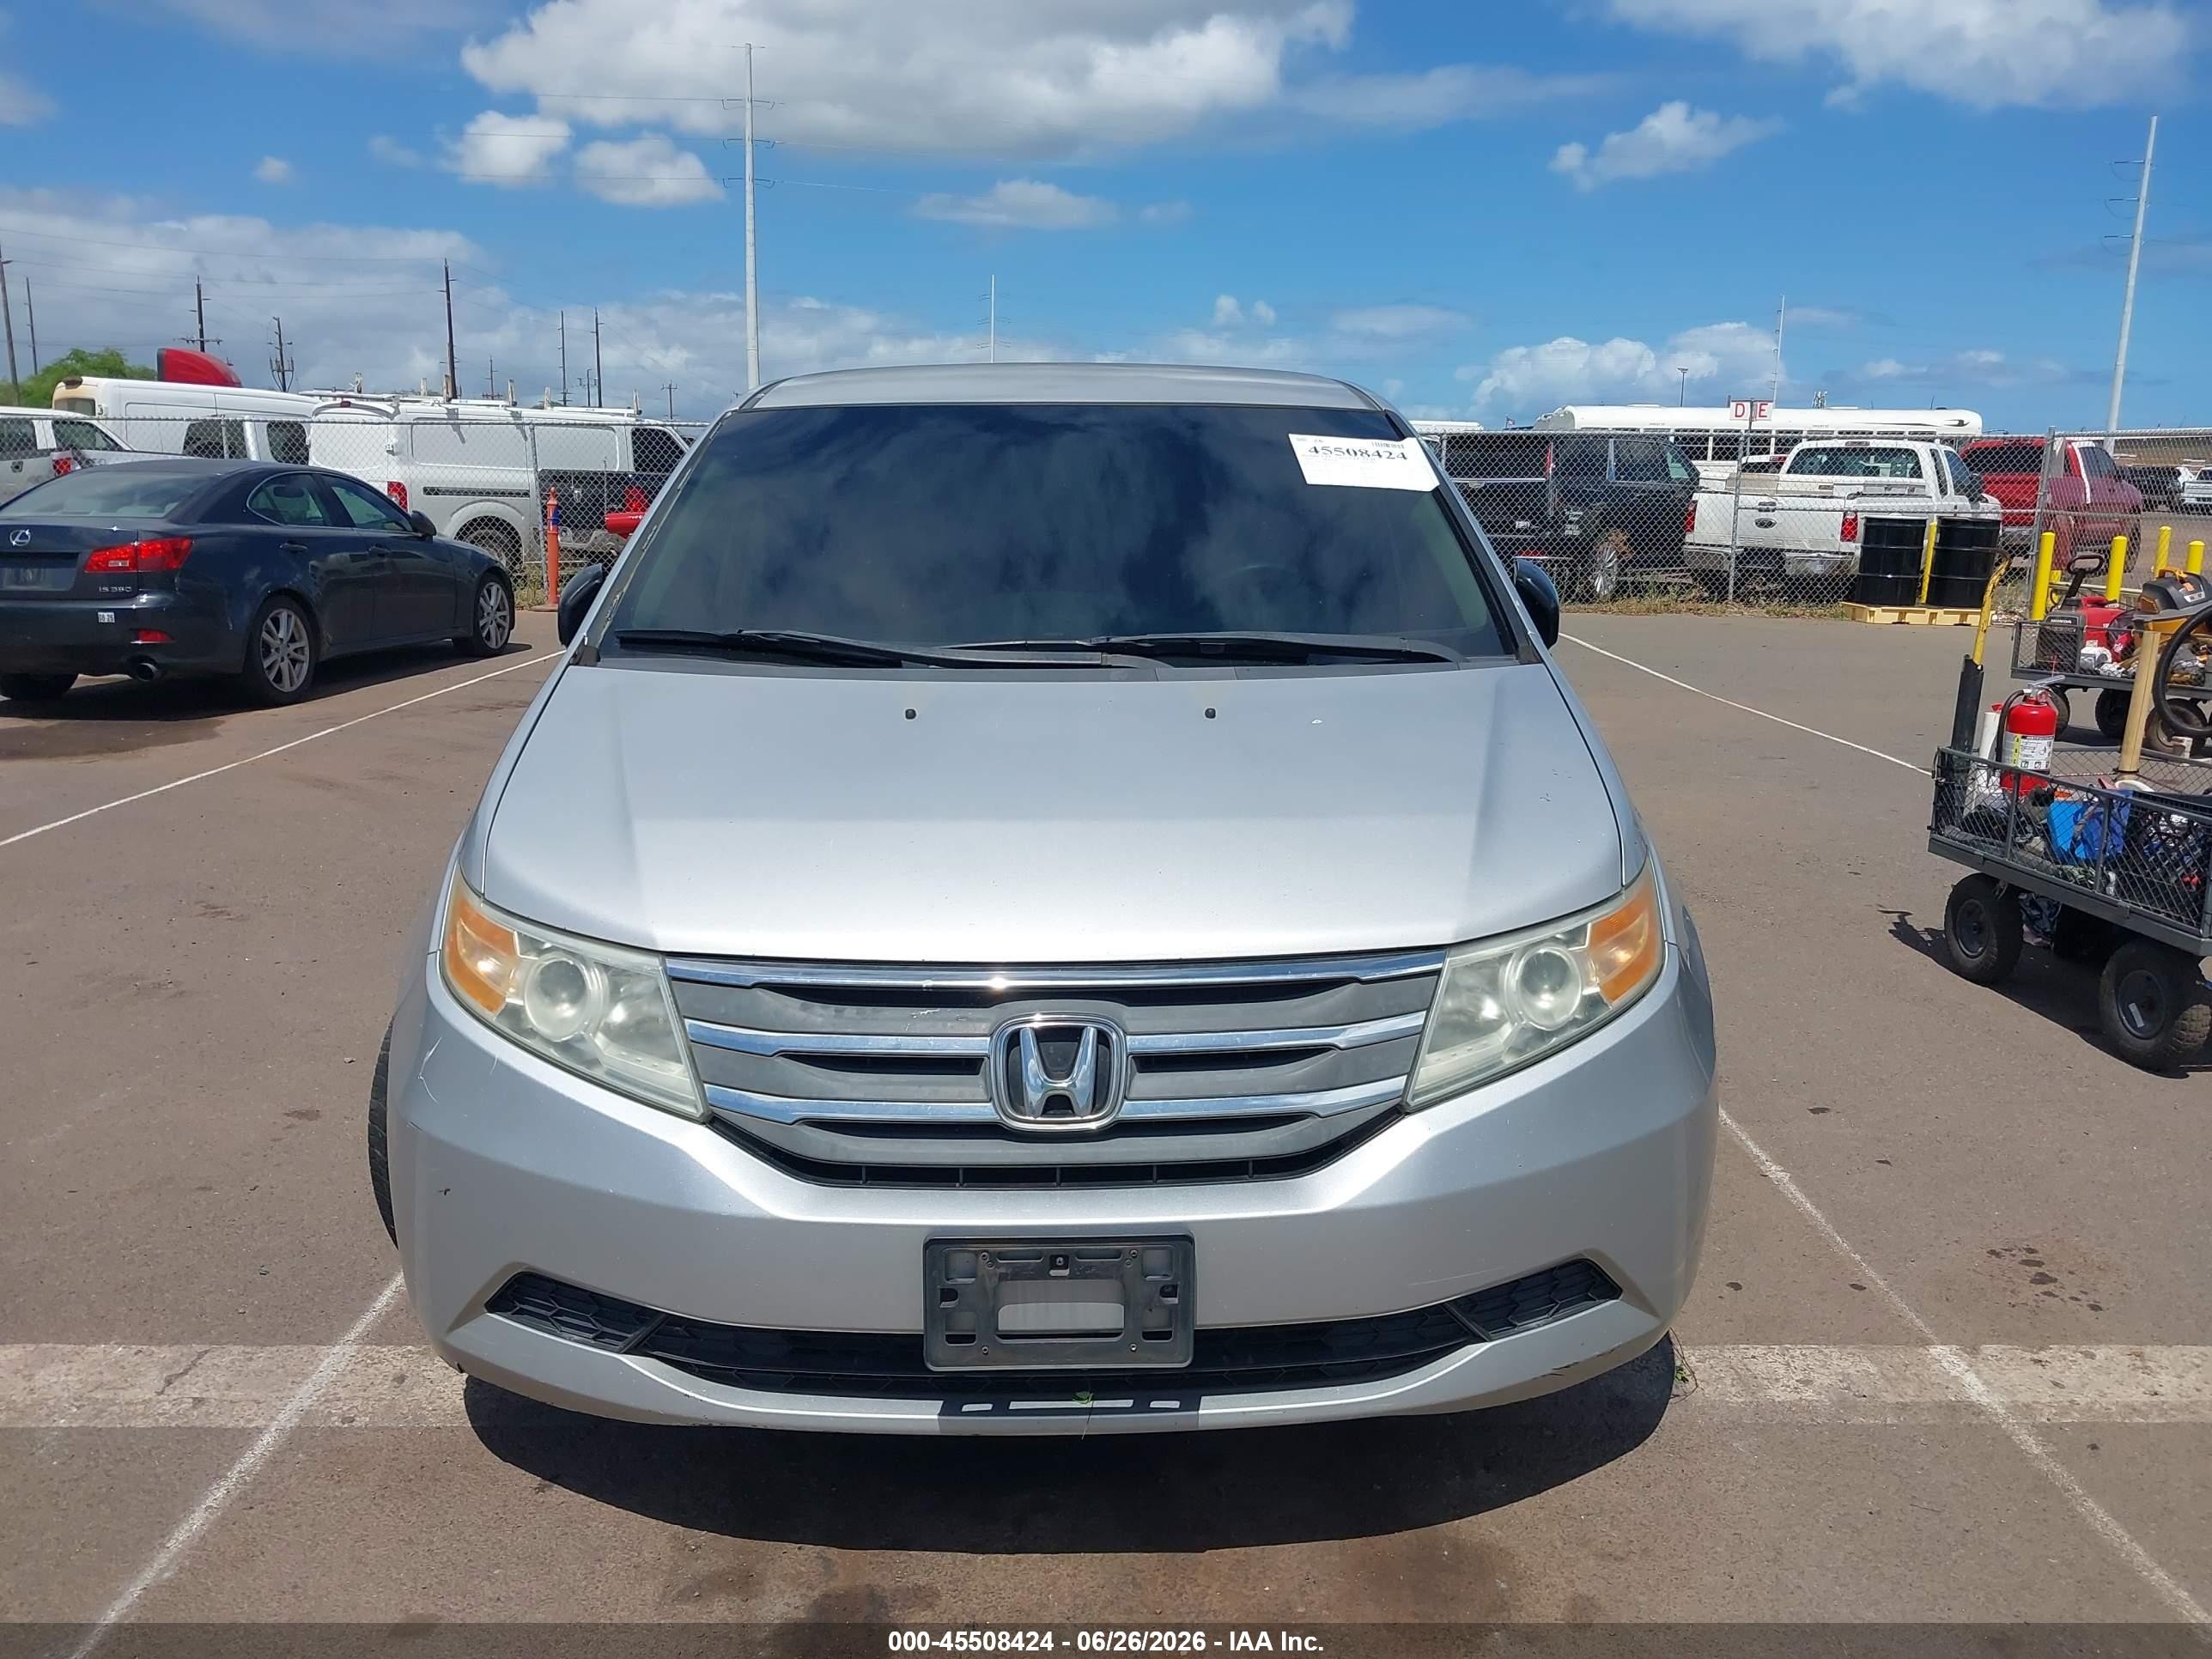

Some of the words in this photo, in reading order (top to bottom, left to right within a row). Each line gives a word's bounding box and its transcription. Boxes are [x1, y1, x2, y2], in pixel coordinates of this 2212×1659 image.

[1735, 403, 1745, 418] D
[1758, 403, 1769, 418] E
[1308, 446, 1409, 461] 45508424
